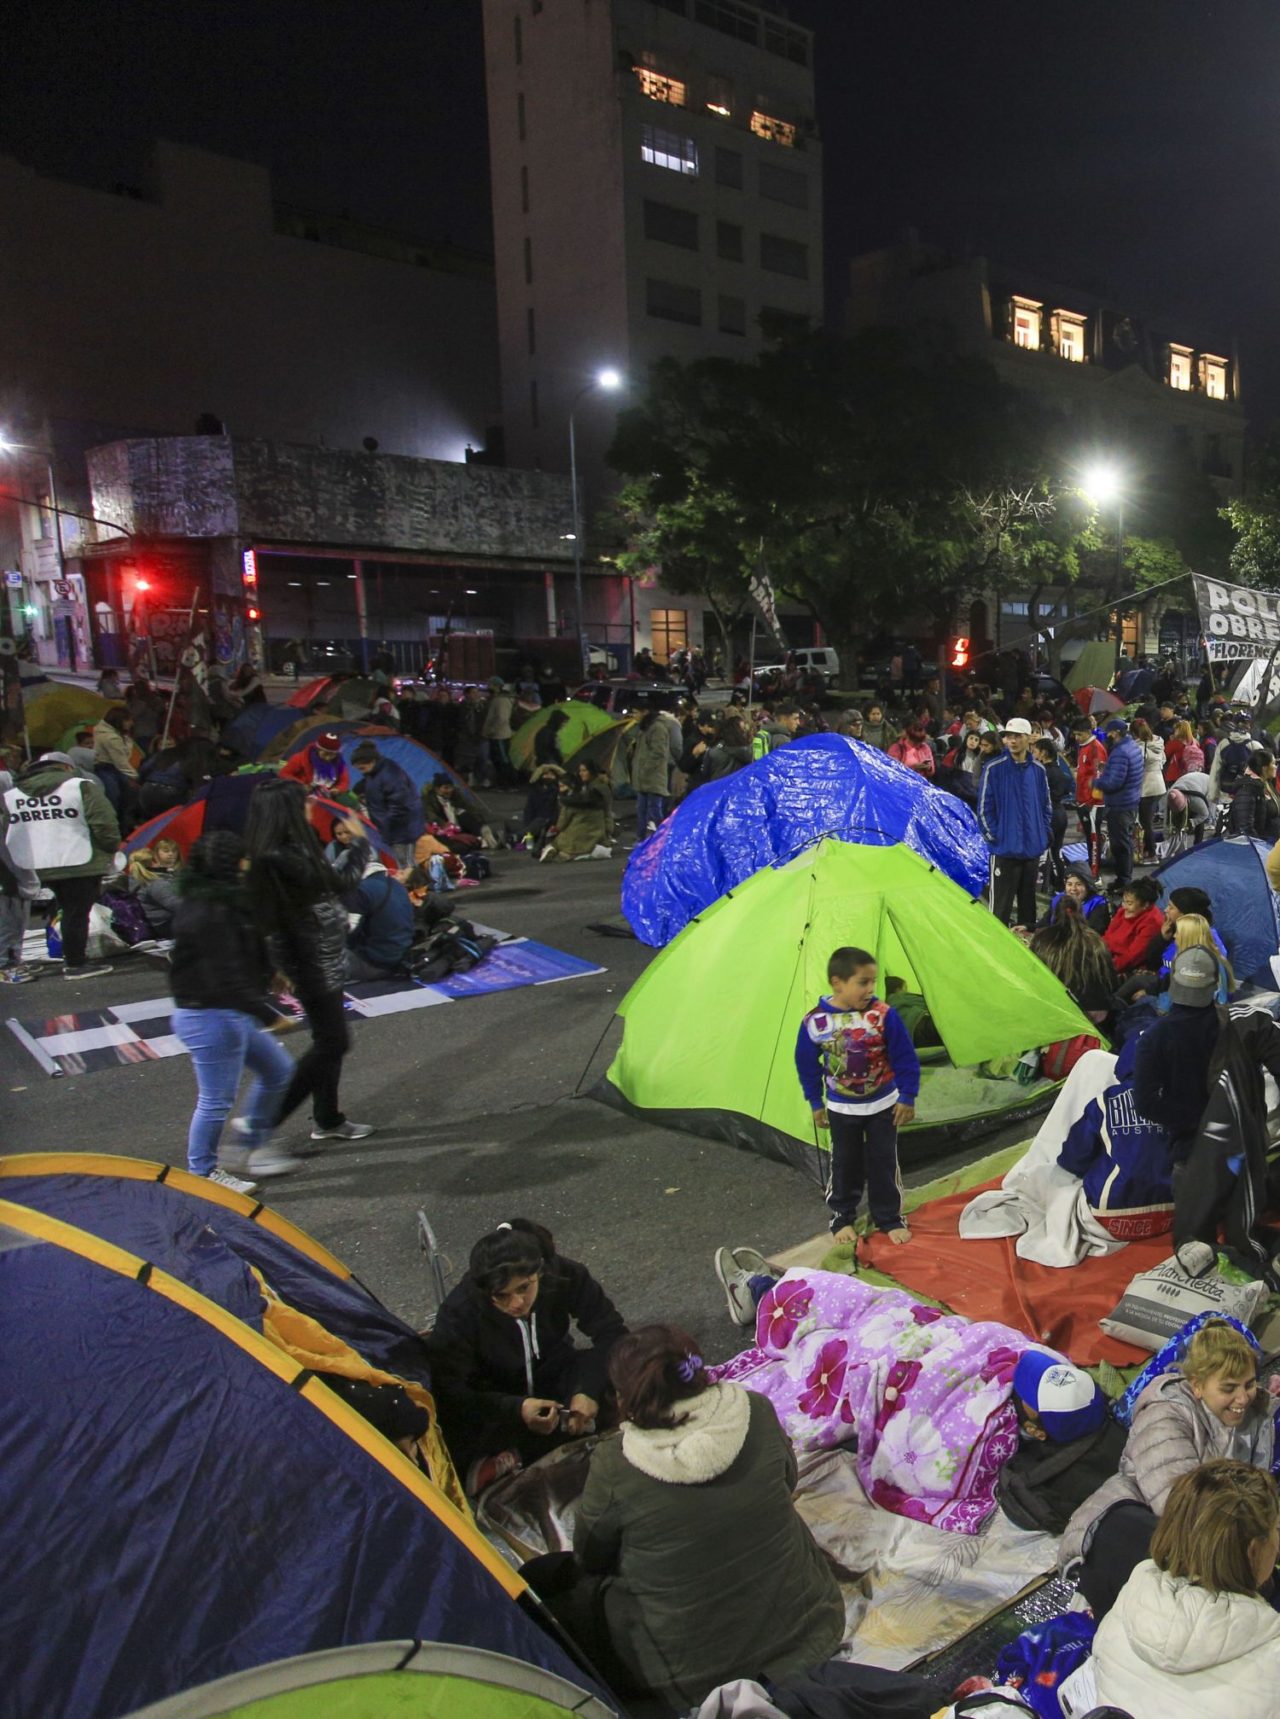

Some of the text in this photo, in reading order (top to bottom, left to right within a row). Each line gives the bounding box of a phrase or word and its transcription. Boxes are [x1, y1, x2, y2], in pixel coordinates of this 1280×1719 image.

[16, 795, 62, 809] POLO
[9, 808, 79, 825] OBRERO
[1111, 1125, 1164, 1136] AUSTR
[1108, 1218, 1153, 1236] SINCE
